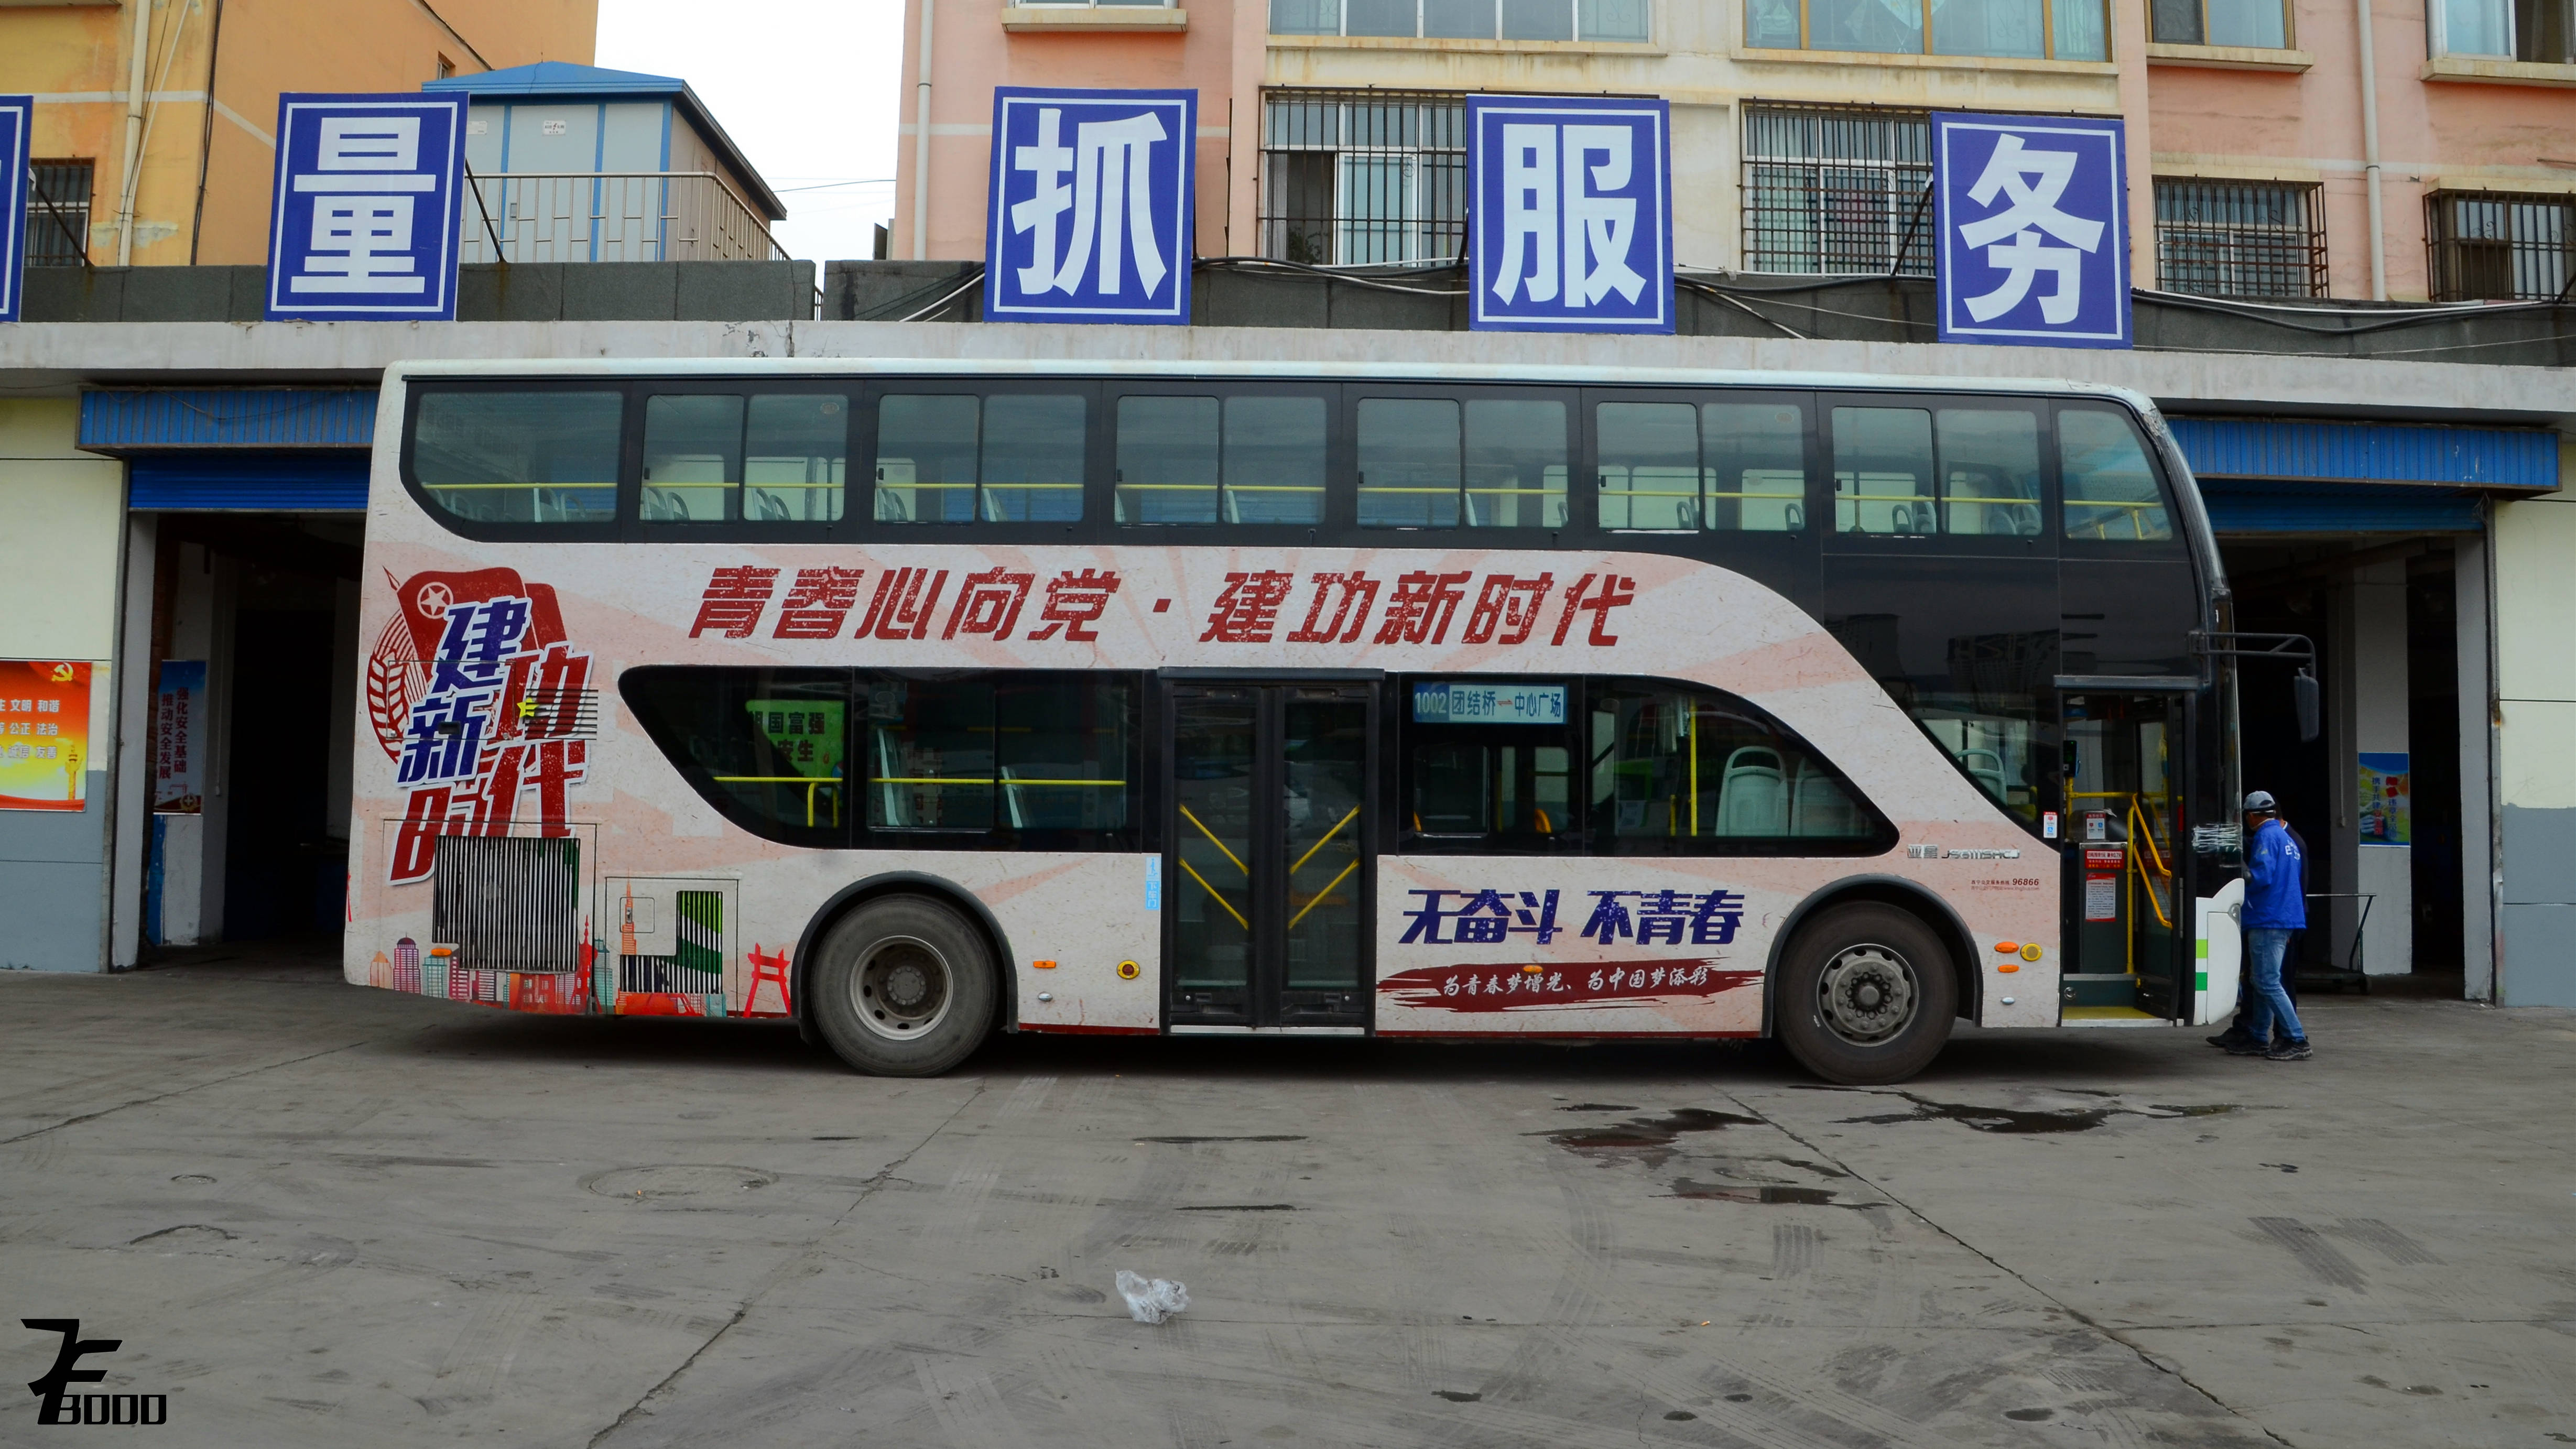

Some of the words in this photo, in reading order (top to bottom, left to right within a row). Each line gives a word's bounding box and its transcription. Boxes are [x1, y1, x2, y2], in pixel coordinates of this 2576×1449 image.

[291, 117, 436, 293] 量
[1012, 108, 1167, 300] 抓
[1492, 124, 1647, 307] 服
[1959, 133, 2105, 324] 务
[9, 722, 31, 735] 公正
[37, 723, 58, 735] 法治
[10, 699, 32, 712] 文明
[38, 700, 60, 712] 和谐
[174, 687, 189, 773] 强化安全基础
[1415, 692, 1447, 714] 1002
[1452, 690, 1496, 716] 团结桥
[1515, 692, 1561, 717] 中心广场
[36, 746, 57, 759] 友善
[159, 693, 174, 779] 推动安全发展
[1398, 889, 1563, 944] 无奋斗
[1580, 889, 1745, 945] 不青春
